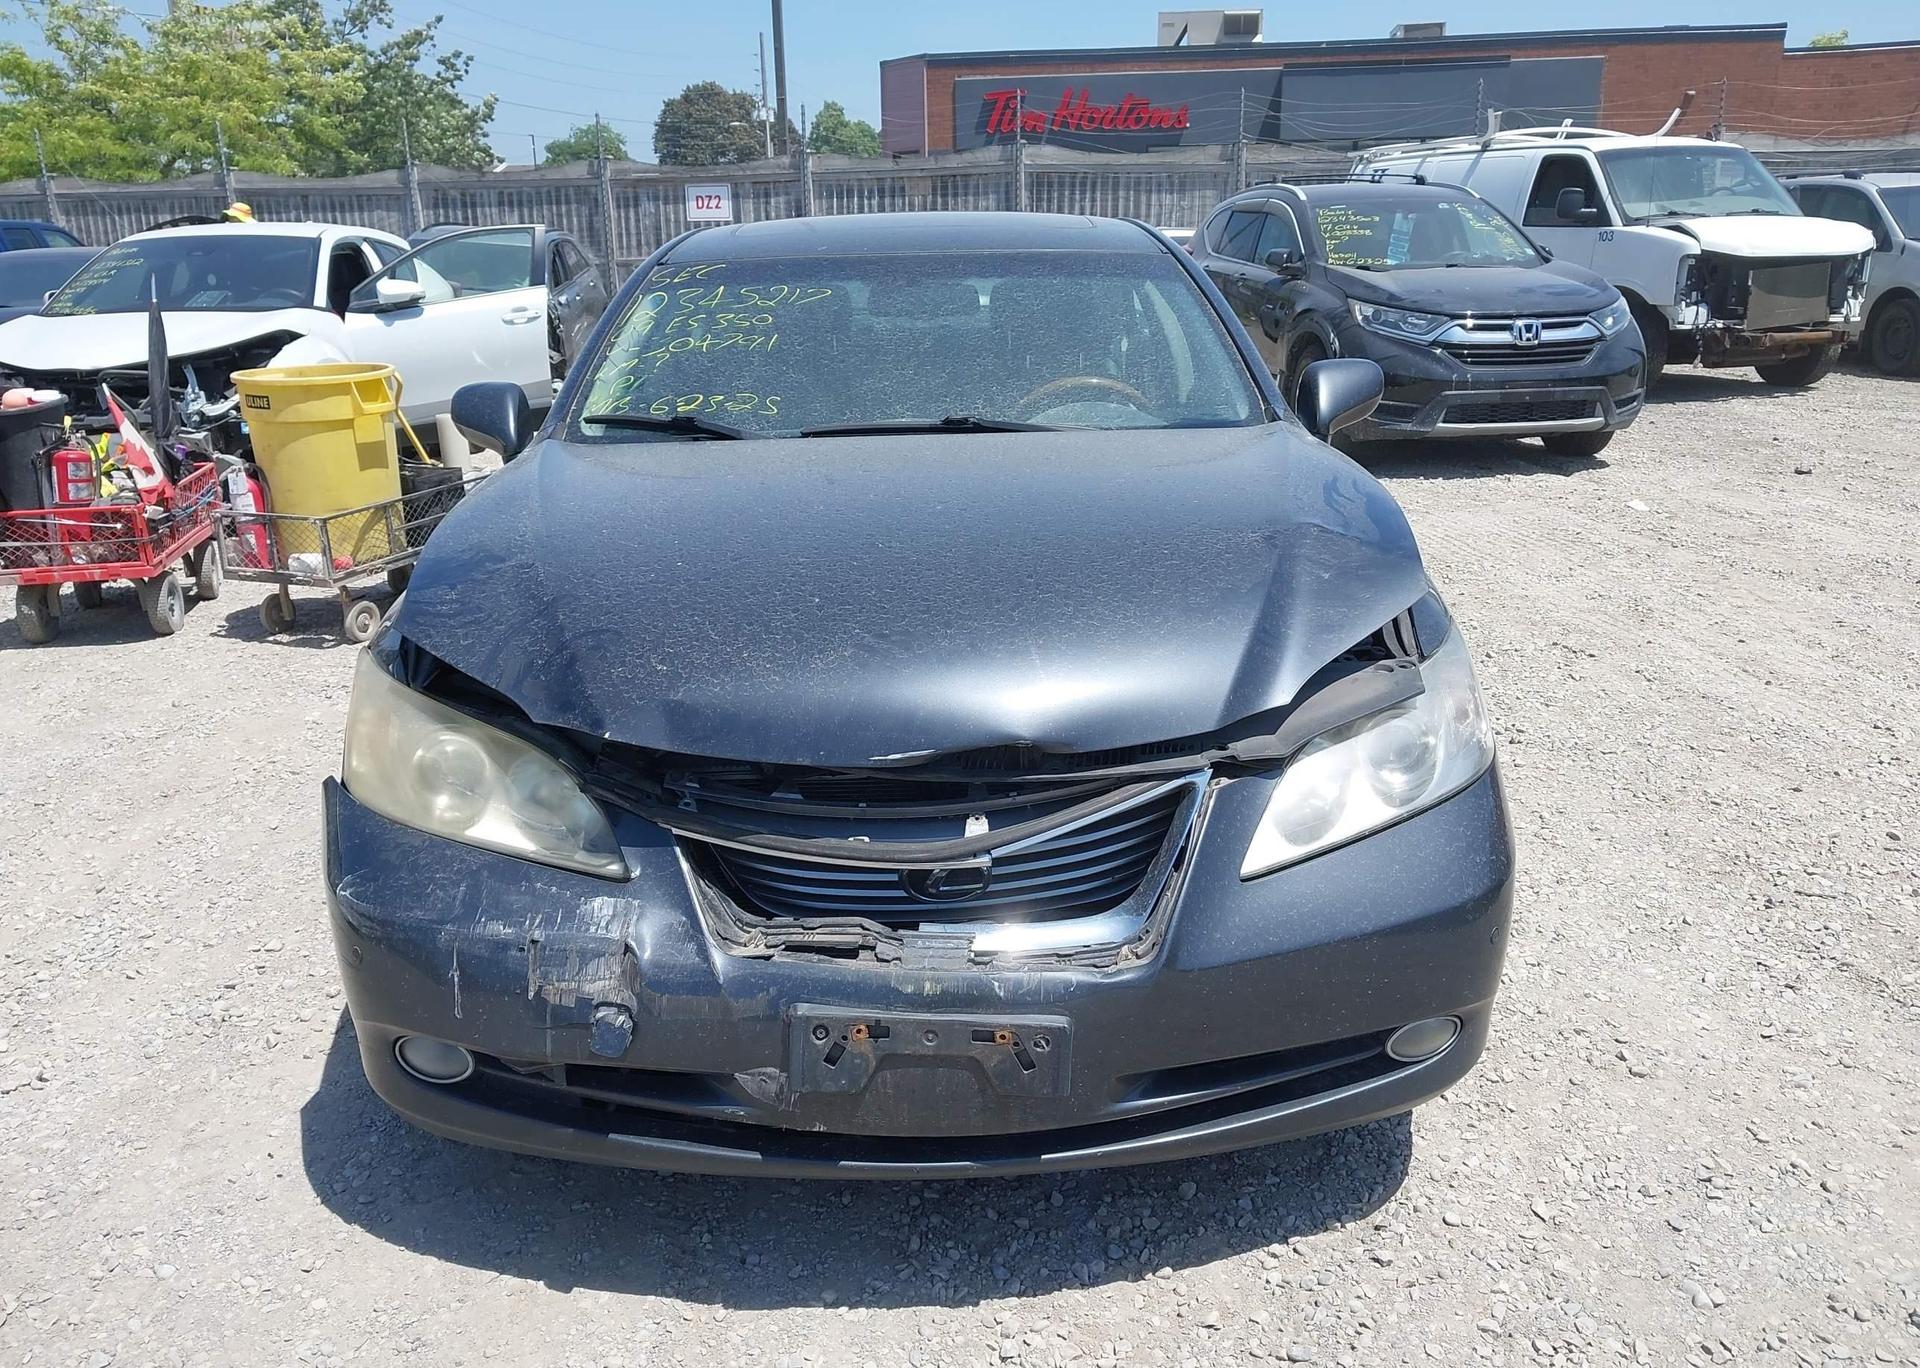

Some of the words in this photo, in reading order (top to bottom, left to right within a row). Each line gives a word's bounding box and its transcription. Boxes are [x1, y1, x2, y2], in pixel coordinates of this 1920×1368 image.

[984, 88, 1047, 133] Tim
[1051, 86, 1190, 131] Hortons
[695, 195, 722, 210] DZ2
[1597, 230, 1615, 242] 103
[651, 263, 727, 289] SEC
[664, 315, 707, 334] ES
[711, 313, 774, 330] 350
[246, 396, 270, 409] ULINE
